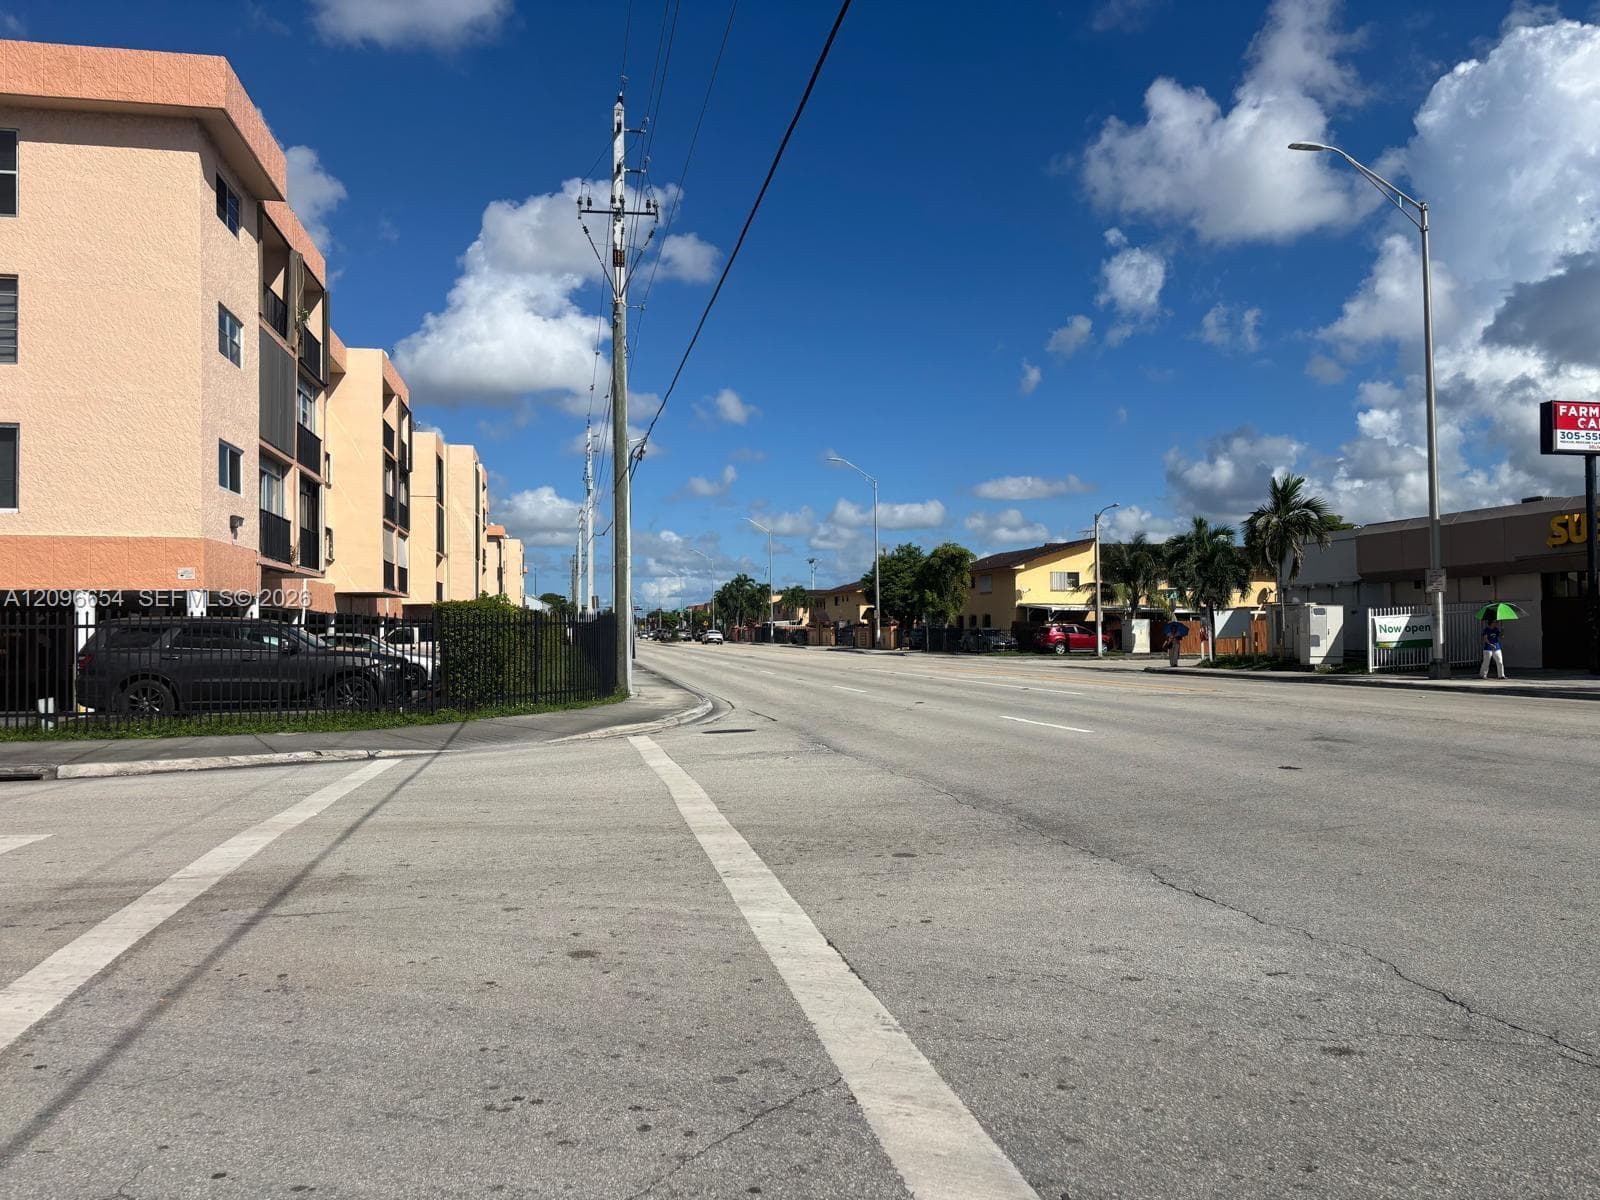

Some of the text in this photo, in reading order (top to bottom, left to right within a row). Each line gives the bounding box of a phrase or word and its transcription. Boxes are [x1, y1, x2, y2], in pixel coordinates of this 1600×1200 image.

[1577, 417, 1600, 429] CA
[1560, 431, 1600, 441] 305-55
[1378, 624, 1431, 635] Now open
